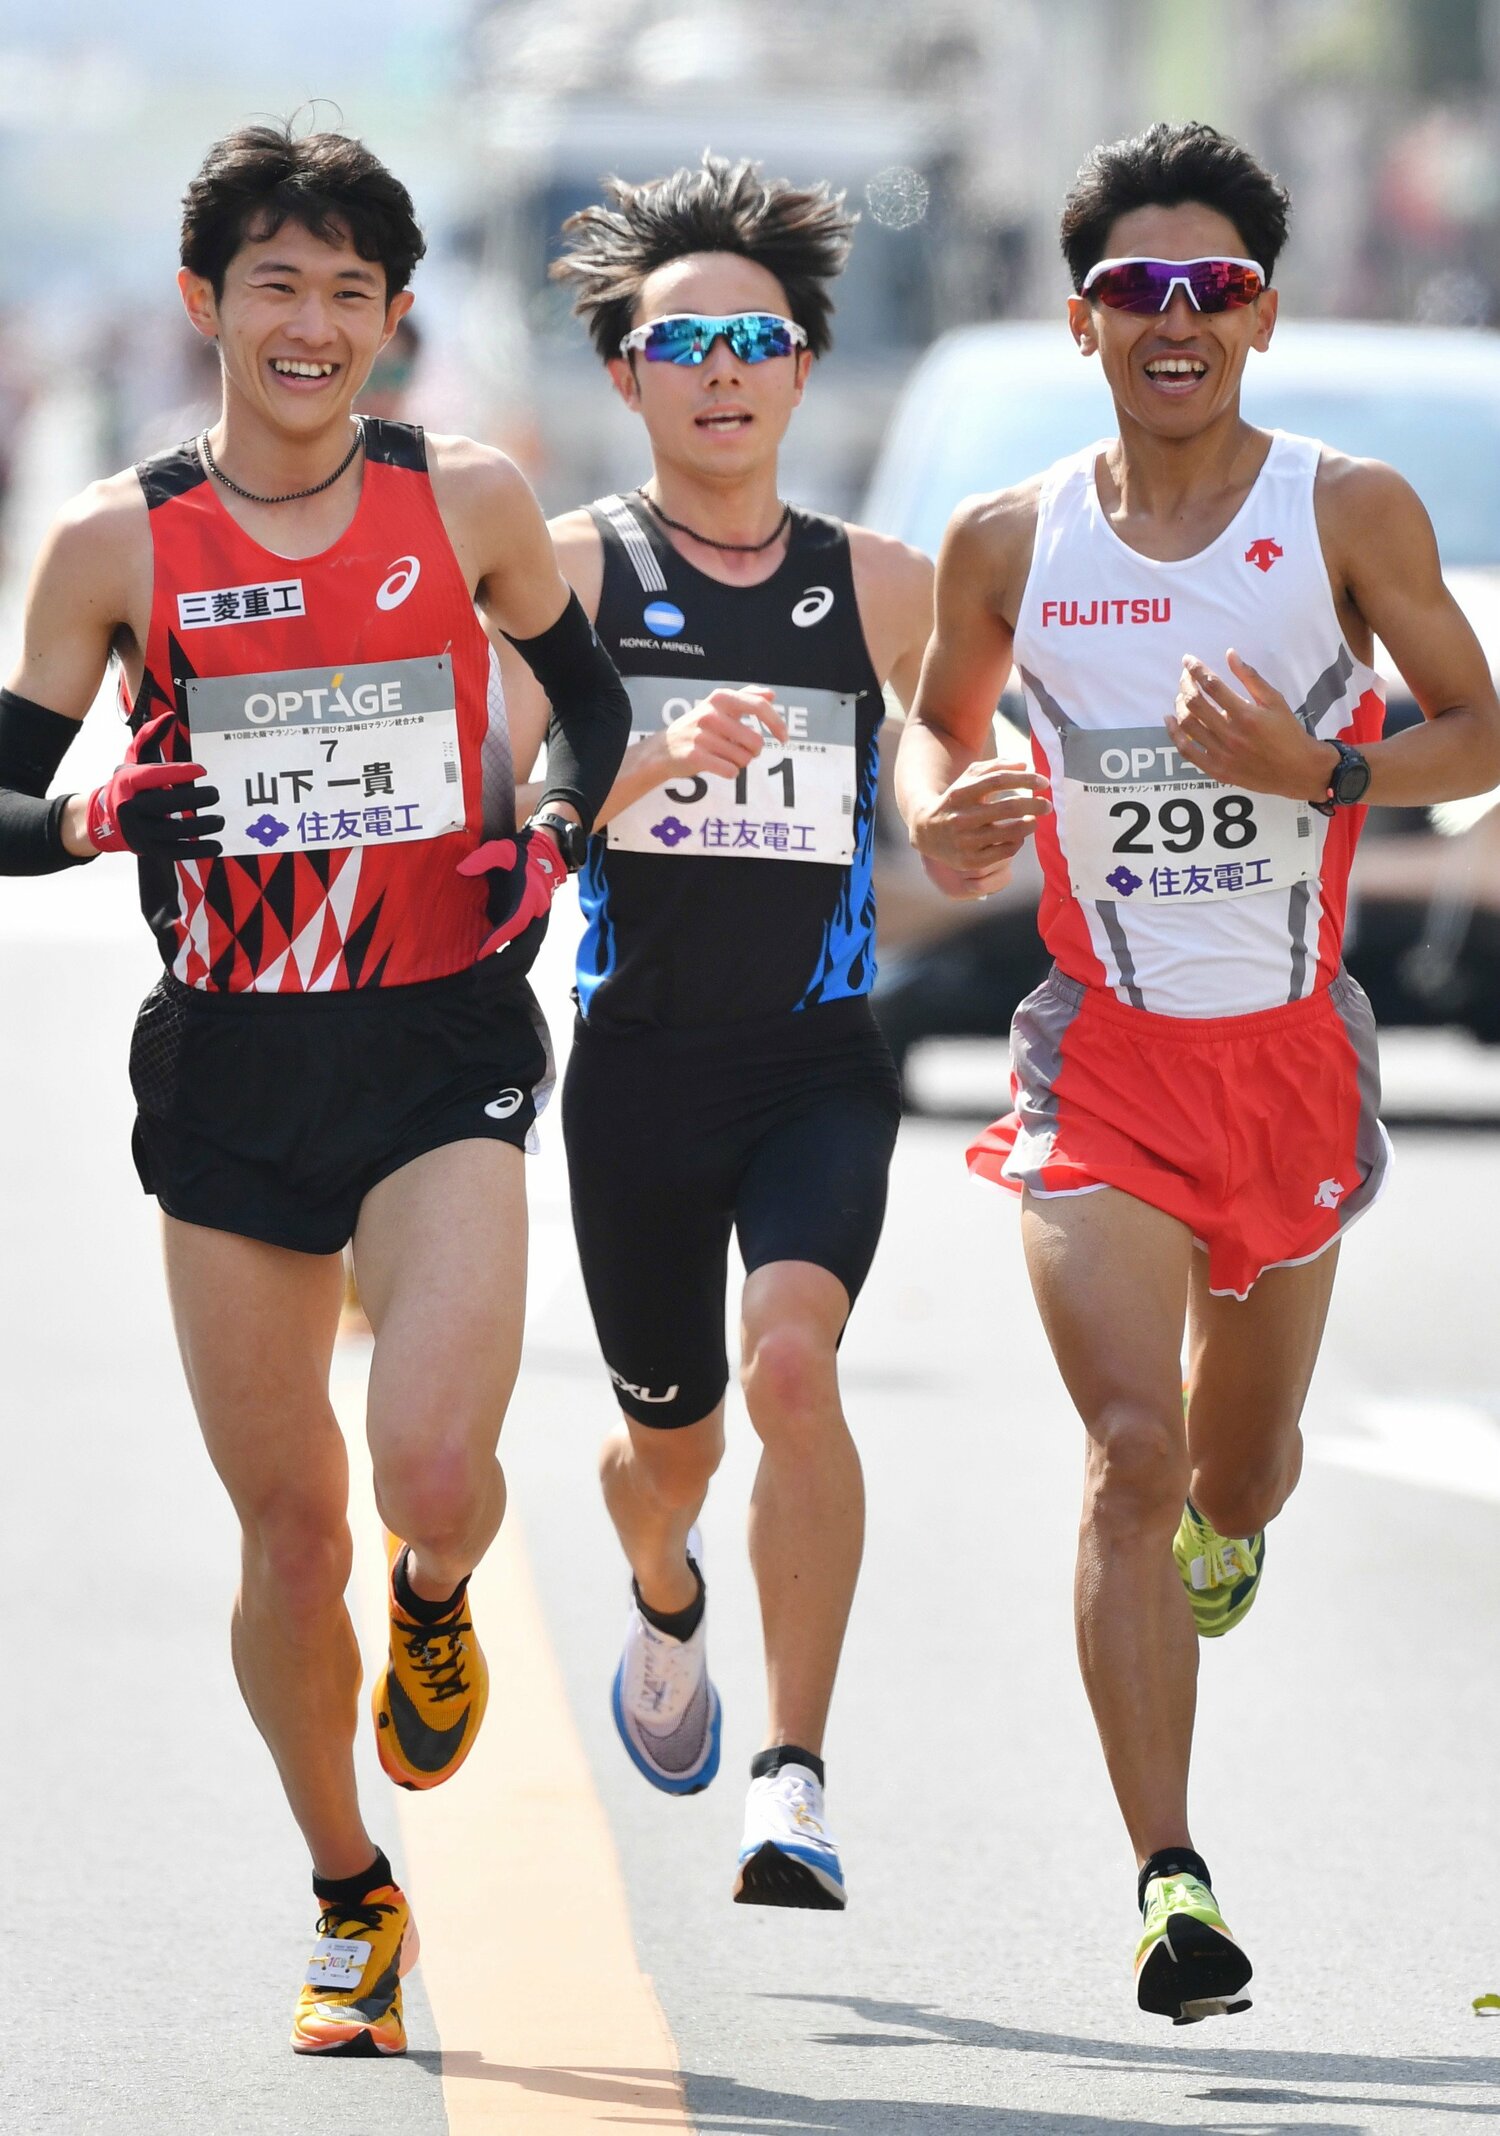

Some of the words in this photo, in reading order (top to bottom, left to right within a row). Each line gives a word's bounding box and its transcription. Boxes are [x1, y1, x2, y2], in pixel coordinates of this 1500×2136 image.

[182, 584, 302, 624] 三菱重工
[1042, 597, 1172, 627] FUJITSU
[619, 637, 660, 649] KONICA
[661, 640, 706, 656] MINOLTA
[244, 678, 403, 722] OPTAGE
[319, 739, 339, 763] 7
[1099, 747, 1205, 780] OPT
[245, 770, 314, 807] 山下
[327, 761, 395, 798] 一貴
[297, 803, 425, 844] 住友電工
[699, 818, 817, 852] 住友電工
[1108, 795, 1257, 854] 298
[1149, 858, 1273, 897] 住友電工
